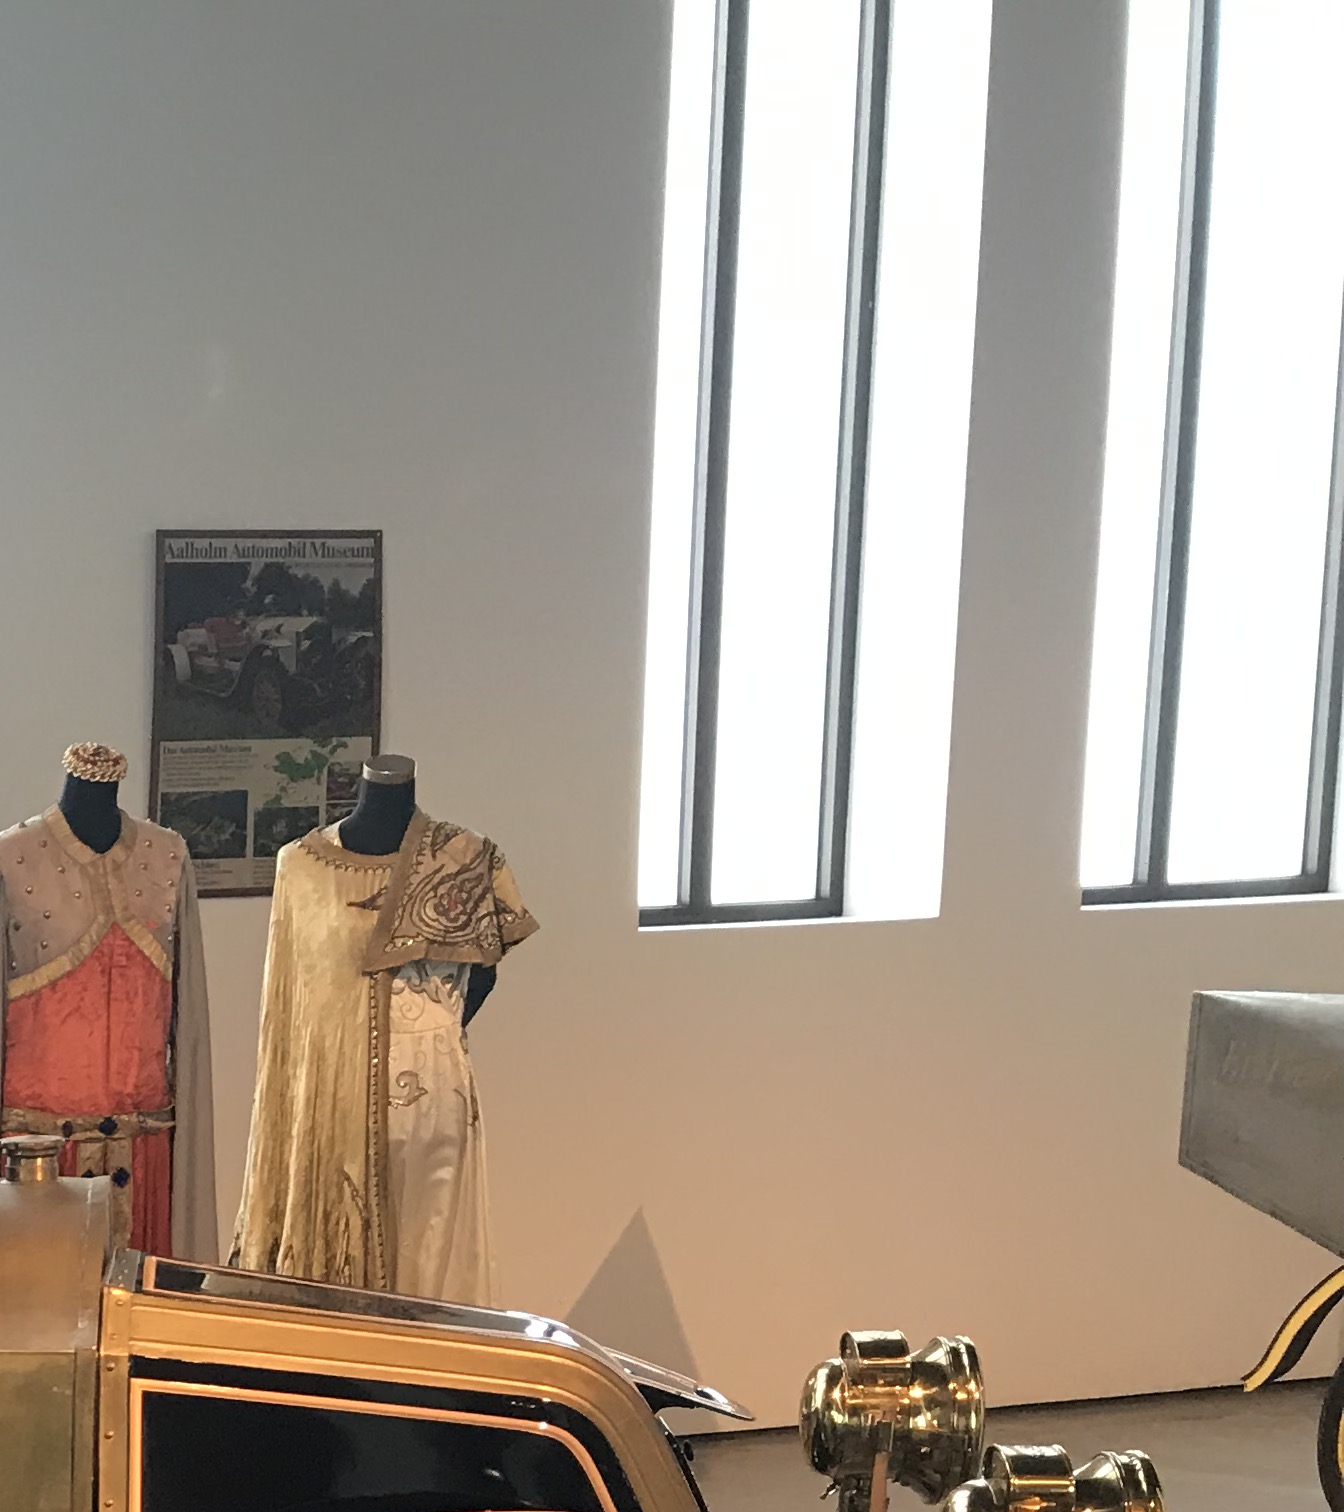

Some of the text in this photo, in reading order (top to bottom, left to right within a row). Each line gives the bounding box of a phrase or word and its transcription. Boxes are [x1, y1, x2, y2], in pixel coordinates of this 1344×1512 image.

[165, 541, 375, 560] Aalholm Automobil Museum
